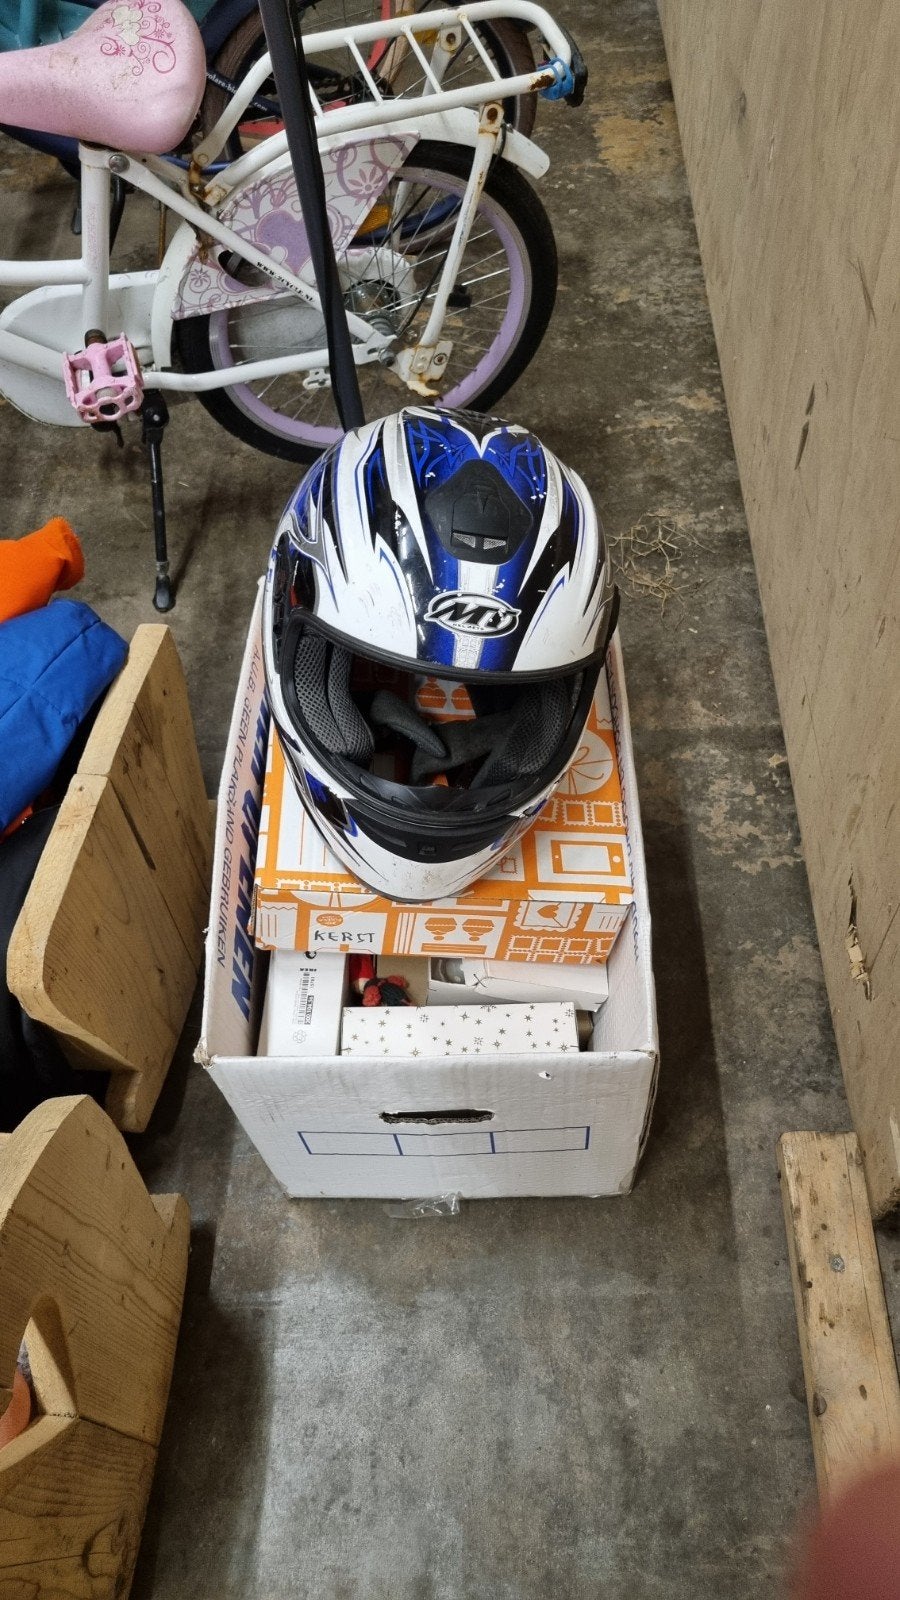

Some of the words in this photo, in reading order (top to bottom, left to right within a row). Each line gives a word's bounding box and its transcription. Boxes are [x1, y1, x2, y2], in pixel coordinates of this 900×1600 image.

[235, 697, 252, 748] GEEN
[217, 847, 233, 969] GEBRUIKEN
[314, 930, 375, 943] KERST
